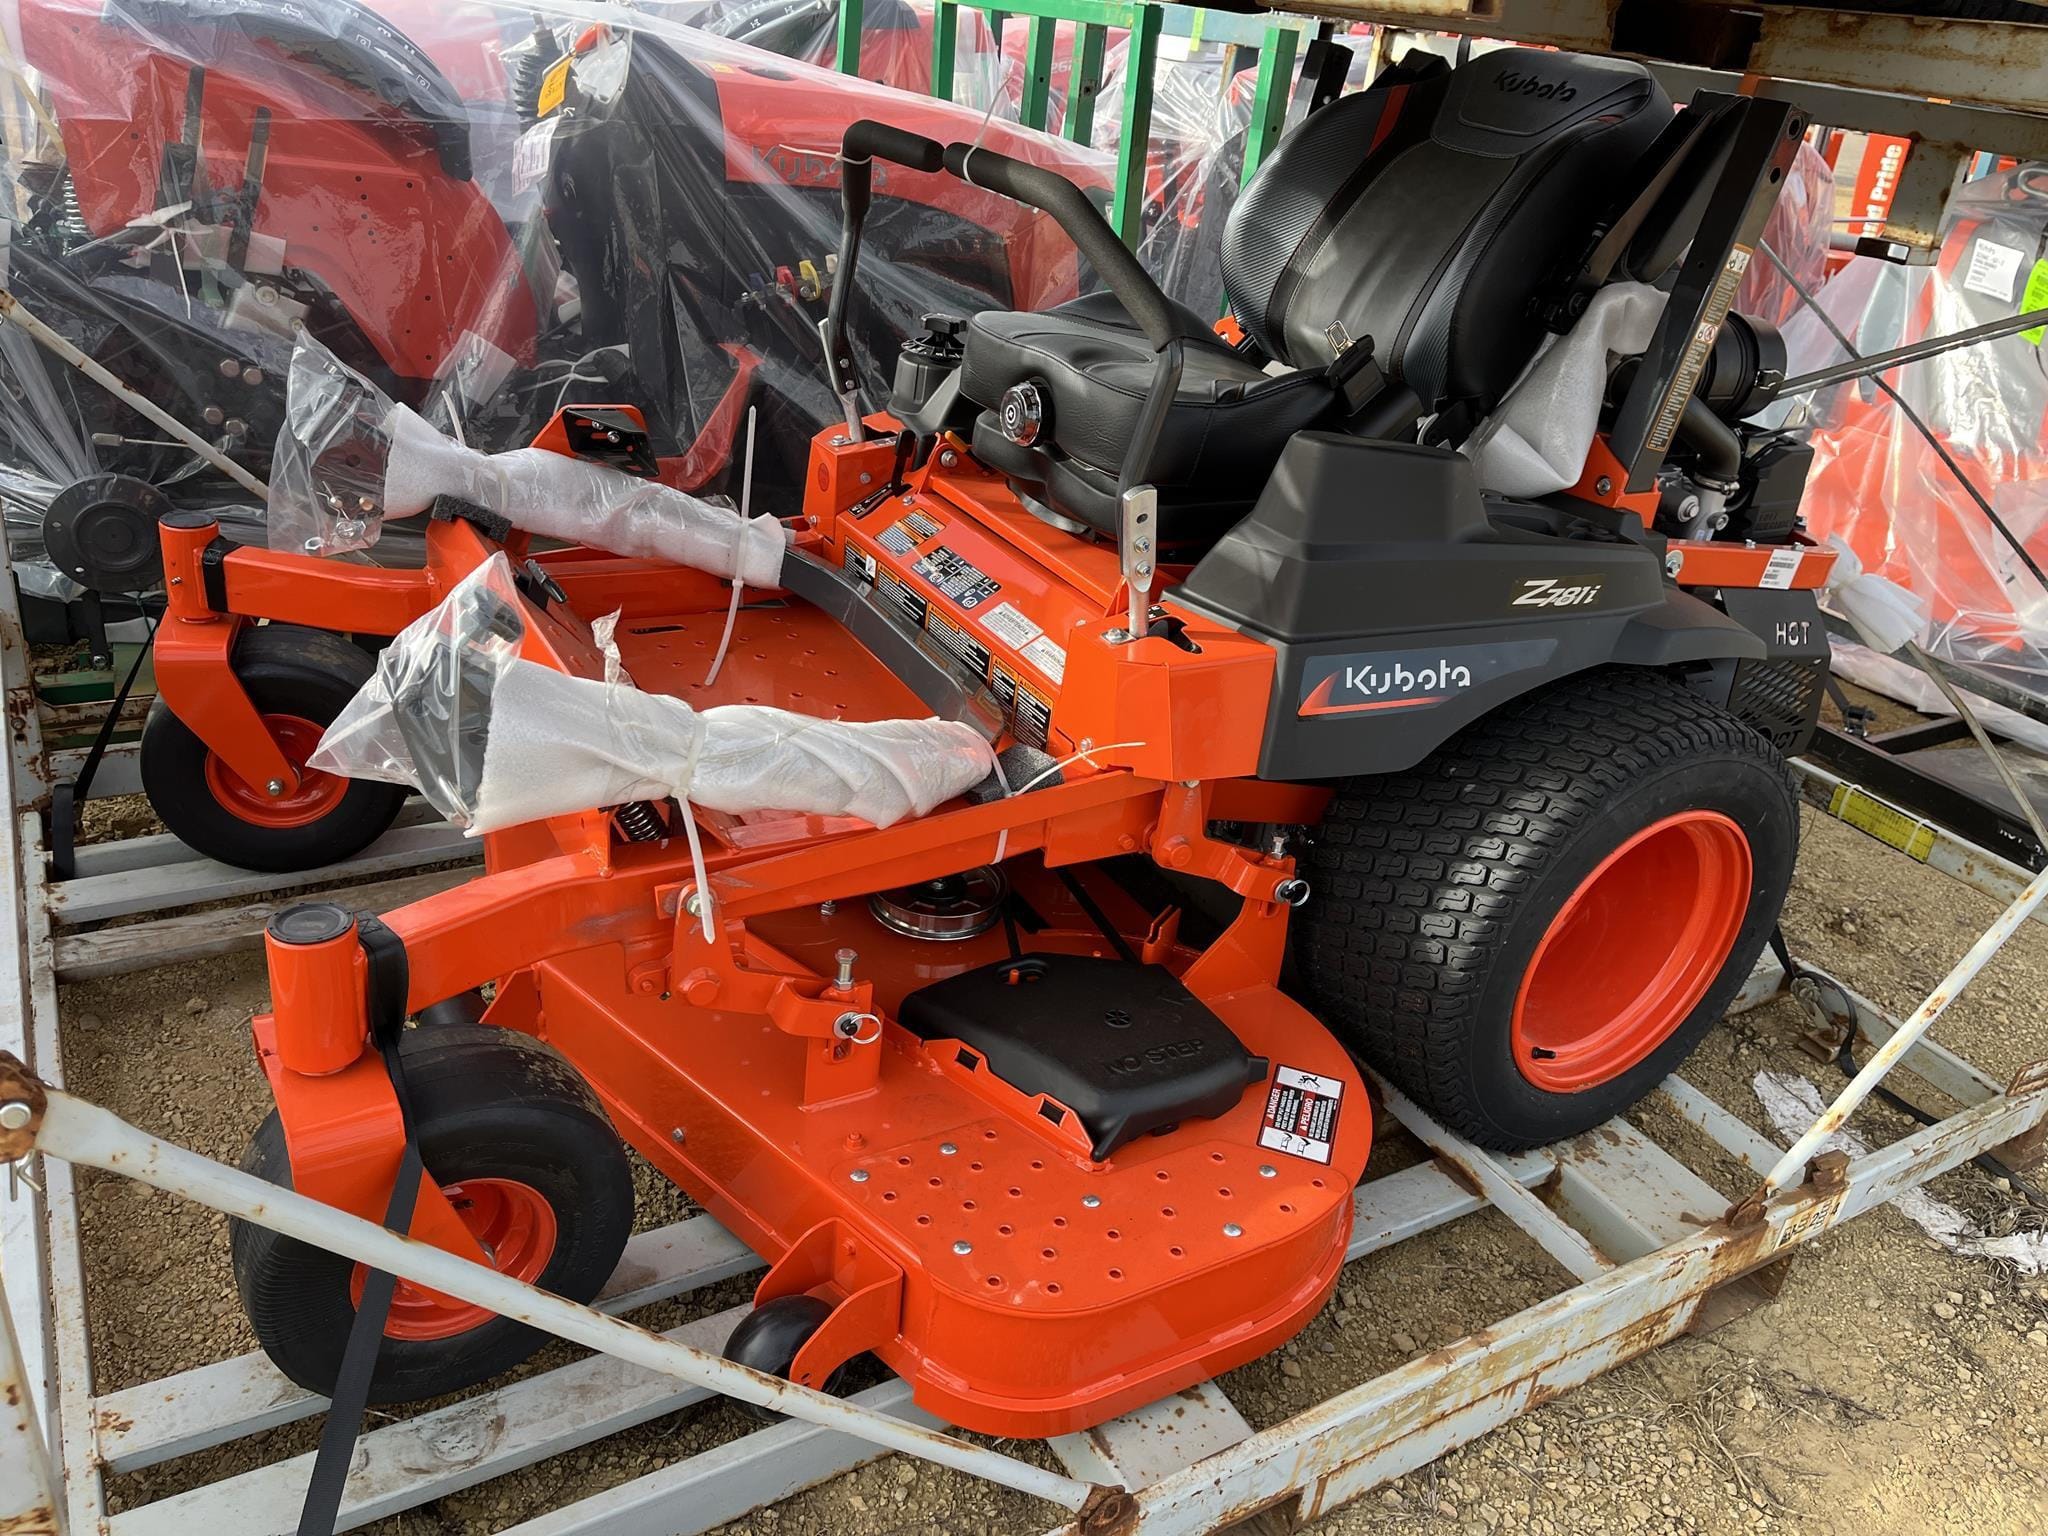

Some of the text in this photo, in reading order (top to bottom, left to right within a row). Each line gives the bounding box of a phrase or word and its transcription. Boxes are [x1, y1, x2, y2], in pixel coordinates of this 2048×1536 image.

[1493, 70, 1577, 102] Kubota
[752, 145, 888, 187] Kuba
[1869, 144, 1902, 202] Pride
[1511, 579, 1602, 608] Z781i
[1775, 621, 1811, 646] HOT
[1346, 659, 1471, 695] Kubota
[1145, 1039, 1204, 1065] STEP
[1268, 1089, 1281, 1114] DANGER
[1302, 1098, 1314, 1124] PELIGRO
